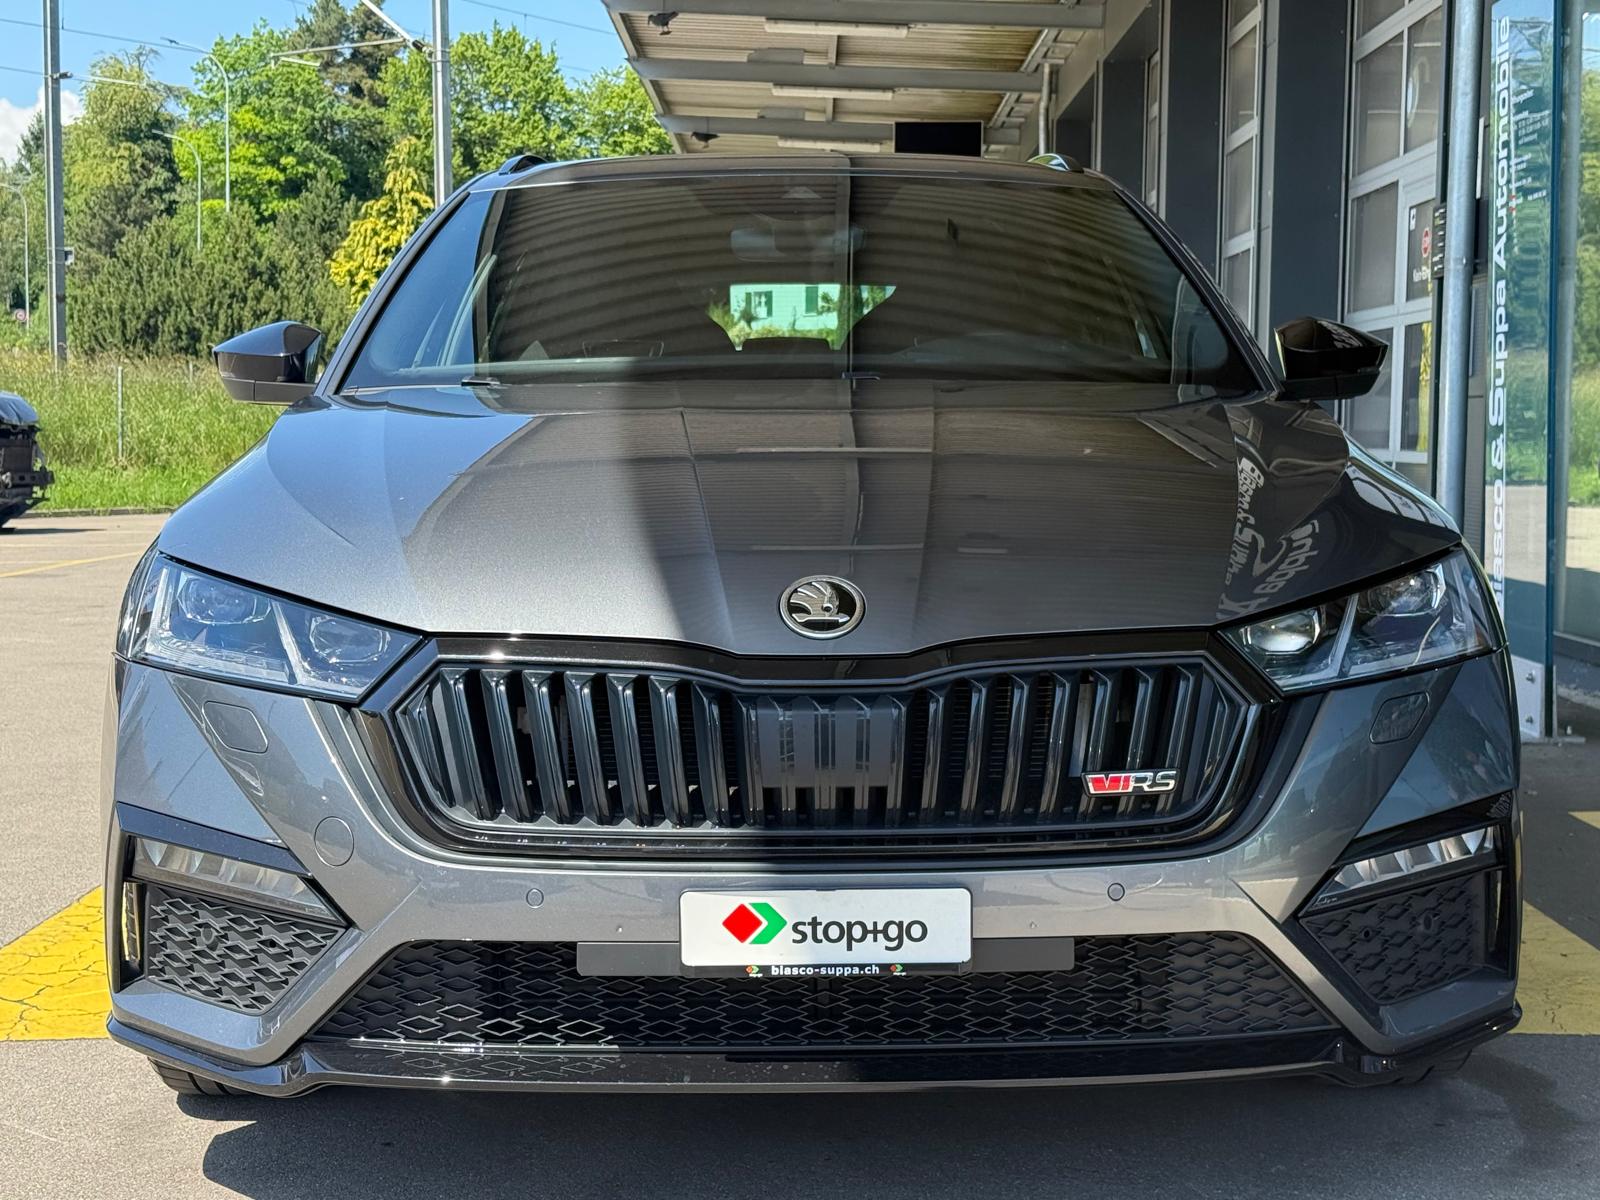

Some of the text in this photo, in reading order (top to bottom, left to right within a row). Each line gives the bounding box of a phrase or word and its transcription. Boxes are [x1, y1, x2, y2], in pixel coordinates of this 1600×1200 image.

[1493, 15, 1510, 270] Automobile
[1489, 279, 1509, 427] Suppa
[1491, 433, 1504, 471] &
[791, 915, 928, 951] stop+go
